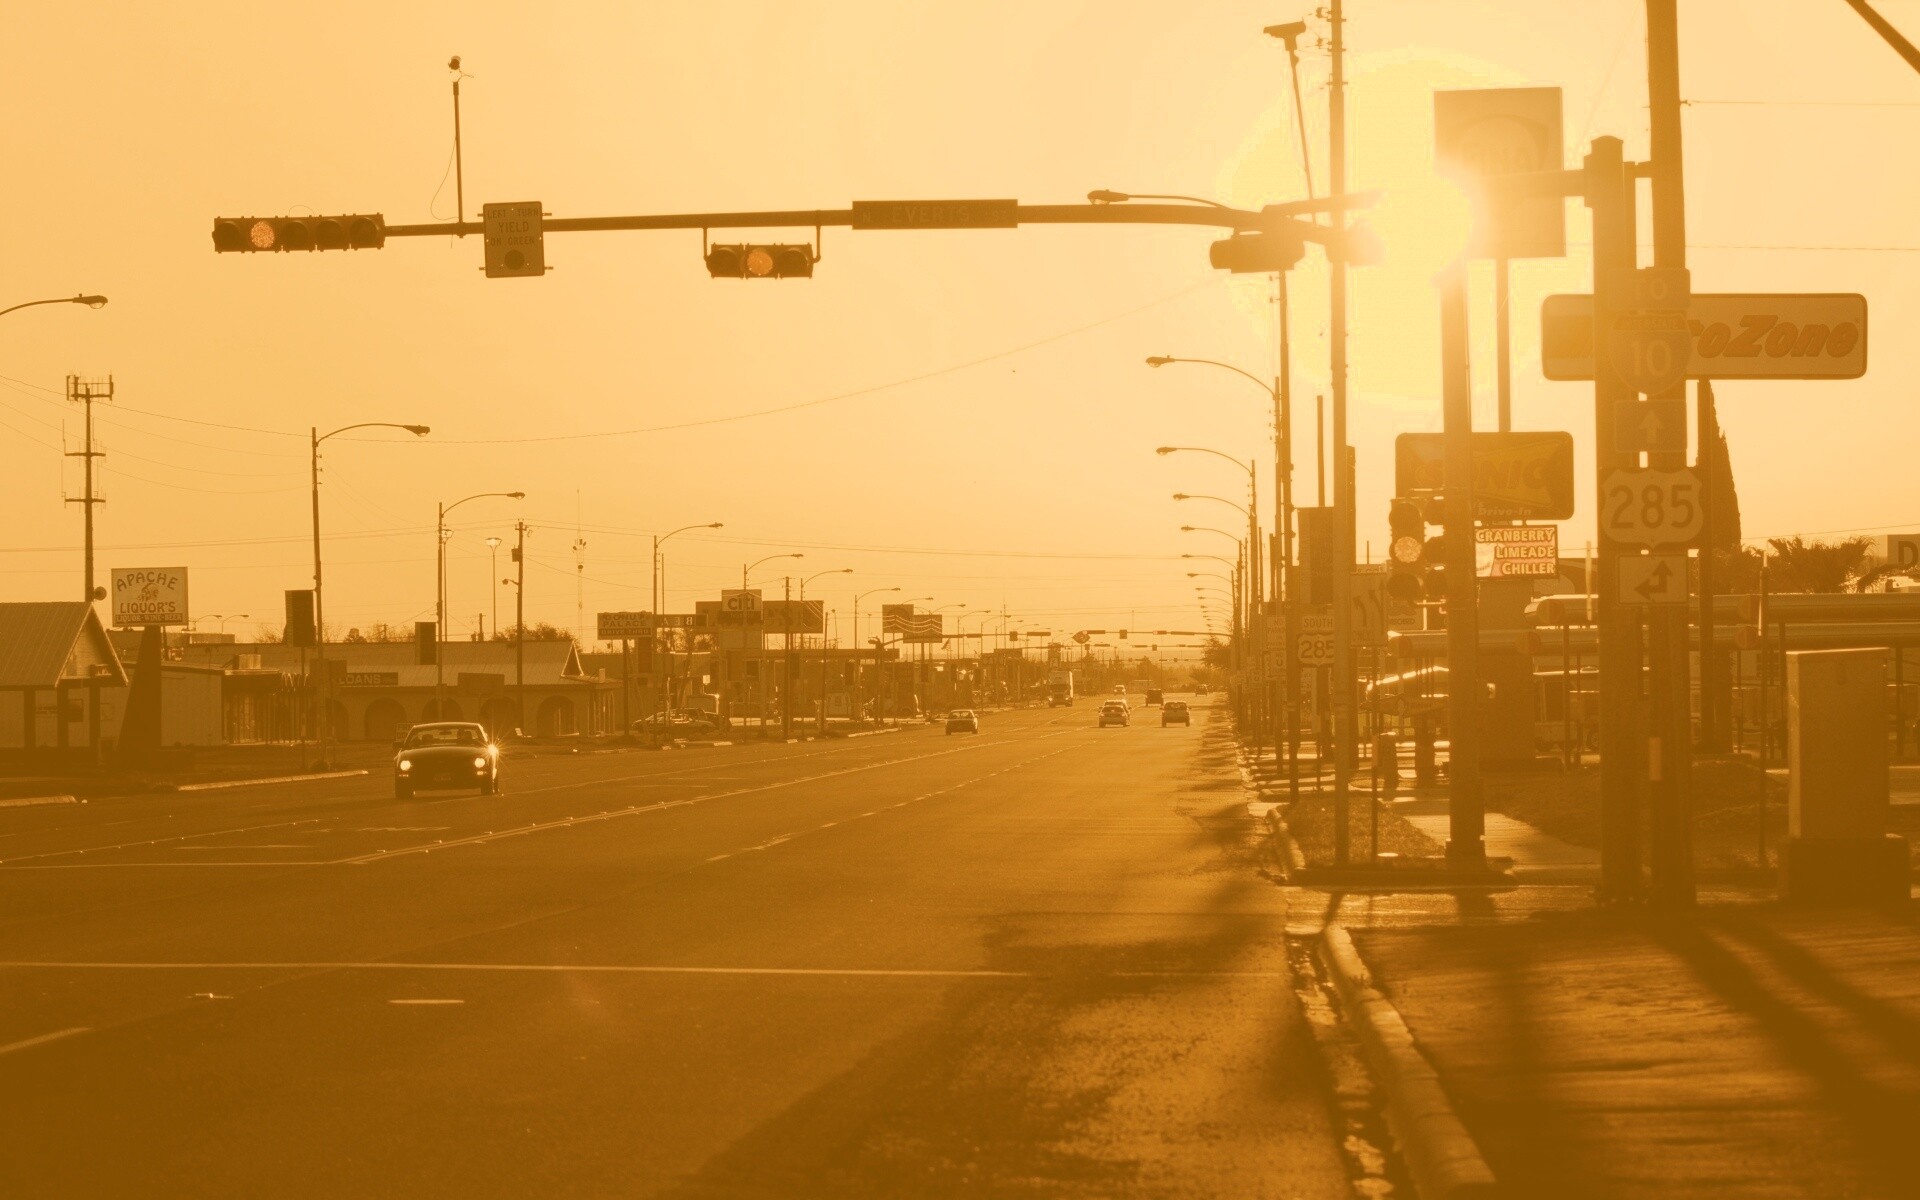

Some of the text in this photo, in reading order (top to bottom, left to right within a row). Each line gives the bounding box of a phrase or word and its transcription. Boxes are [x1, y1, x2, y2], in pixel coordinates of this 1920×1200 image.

[487, 208, 539, 219] LEFT TURN
[498, 221, 529, 233] YIELD
[490, 236, 535, 247] ON GREEN
[1631, 339, 1672, 376] 10
[1609, 484, 1694, 529] 285
[1475, 530, 1555, 543] CRANBERRY
[1496, 546, 1555, 559] LIMEADE
[1501, 562, 1555, 575] CHILLER
[117, 571, 179, 592] APACHE
[120, 601, 176, 613] LIQUOR'S
[1303, 618, 1333, 628] SOUTH
[1301, 640, 1334, 658] 285
[338, 673, 382, 685] LOANS
